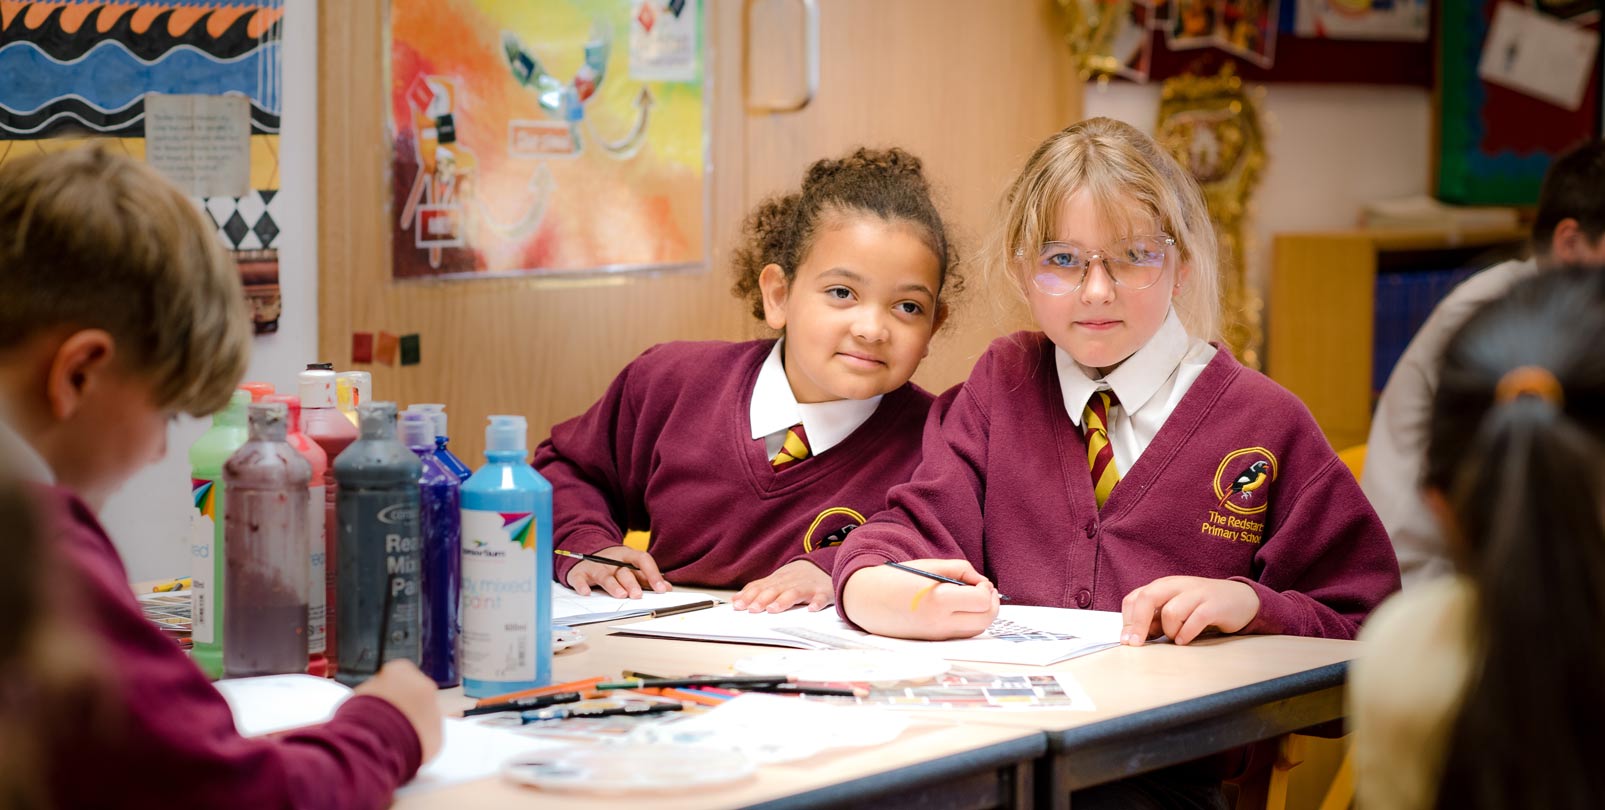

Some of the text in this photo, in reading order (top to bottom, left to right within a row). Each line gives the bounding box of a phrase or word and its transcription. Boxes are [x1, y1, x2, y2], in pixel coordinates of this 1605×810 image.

[1210, 511, 1264, 531] The Redstart
[1202, 523, 1239, 541] Primary
